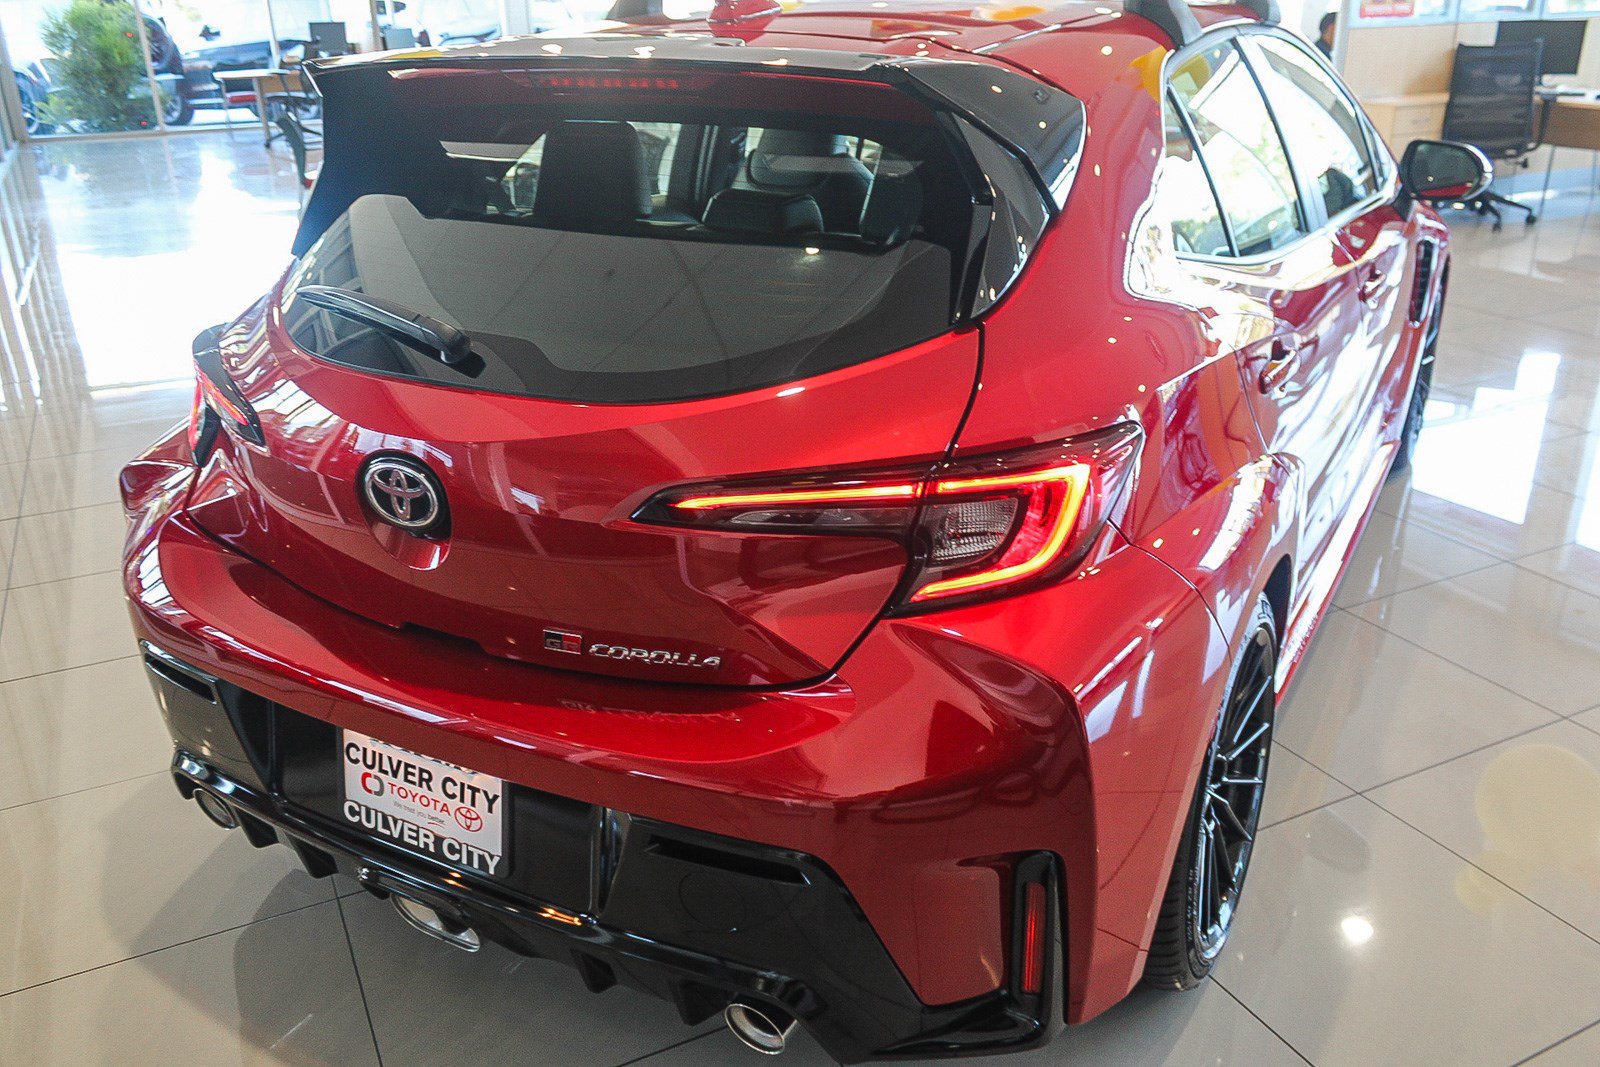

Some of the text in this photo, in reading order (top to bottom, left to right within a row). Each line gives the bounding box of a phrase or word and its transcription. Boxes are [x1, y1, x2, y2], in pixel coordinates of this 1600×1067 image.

[589, 643, 721, 668] COROLLA
[345, 742, 433, 792] CULVER
[441, 777, 500, 814] CITY
[388, 782, 451, 816] TOYOTA
[343, 801, 500, 875] CULVER CITY
